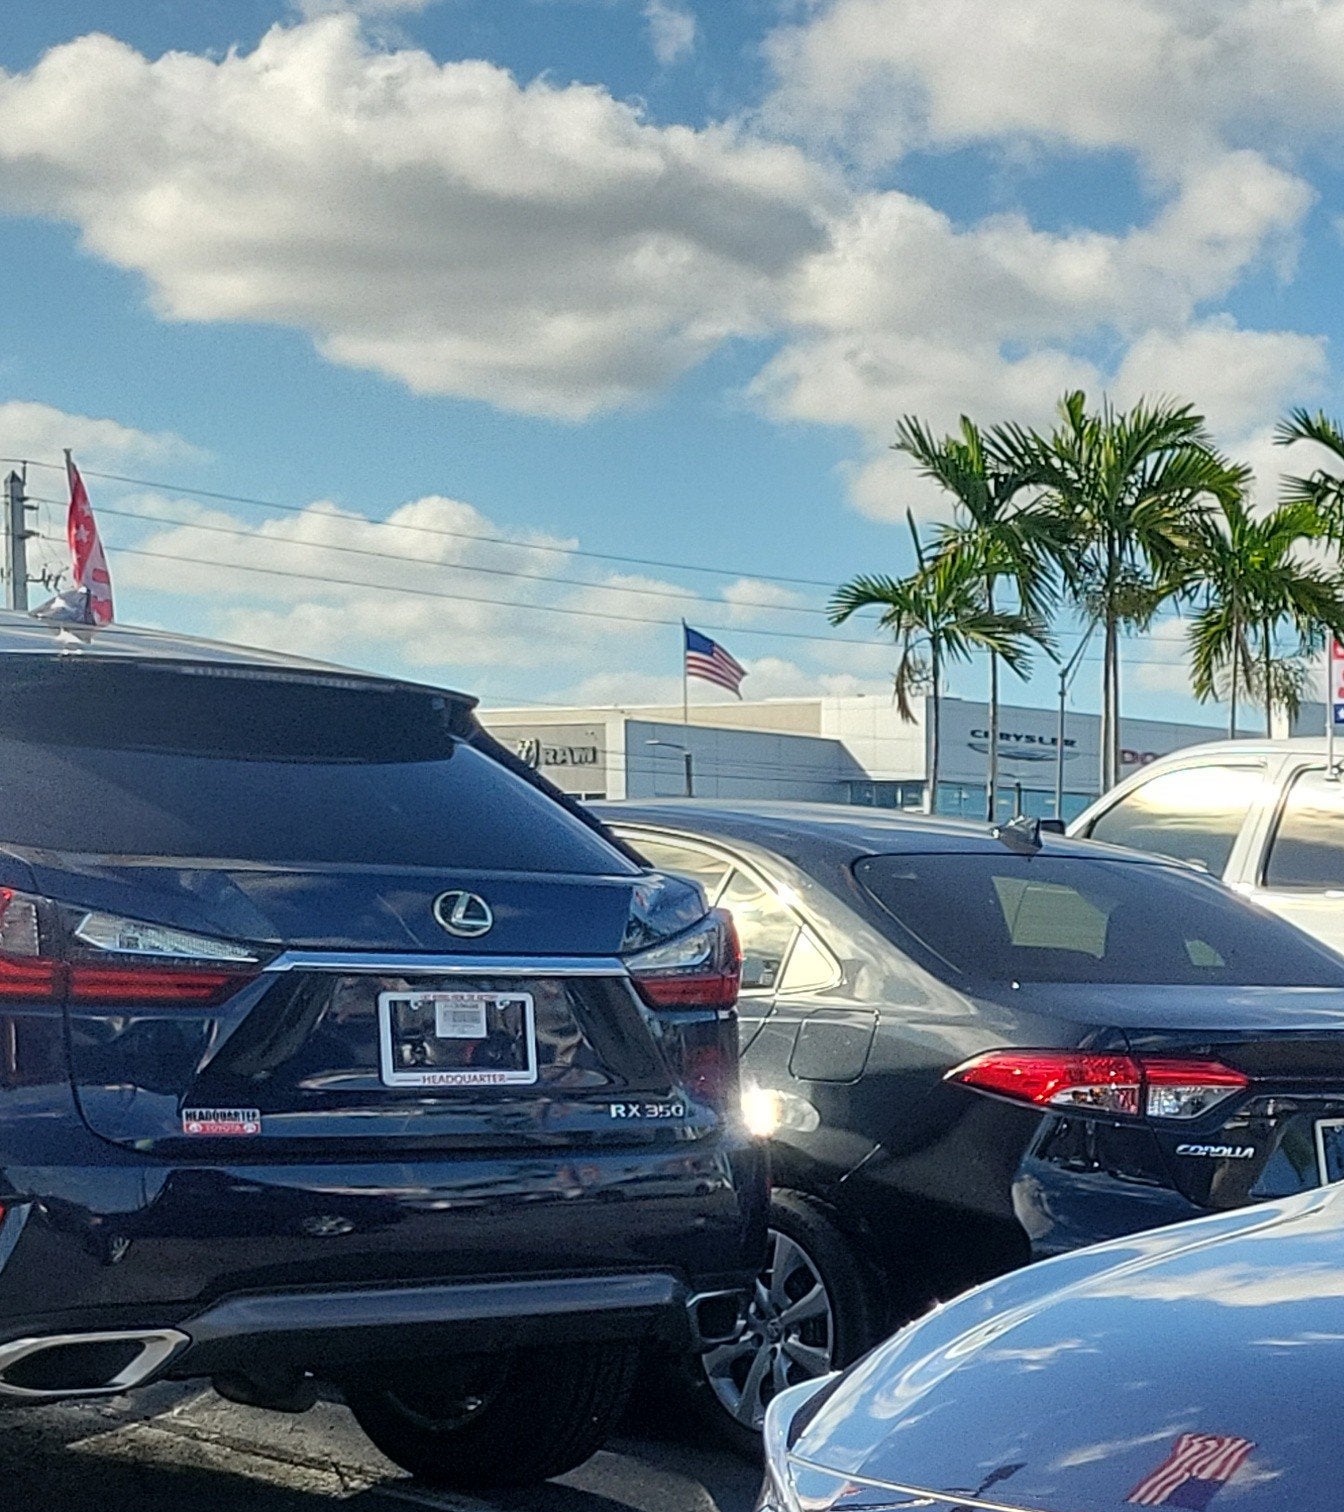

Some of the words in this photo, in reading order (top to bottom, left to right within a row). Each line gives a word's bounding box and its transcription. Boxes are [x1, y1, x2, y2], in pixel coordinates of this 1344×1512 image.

[544, 747, 597, 766] RAM
[421, 1073, 506, 1085] HEADQUARTER
[184, 1109, 259, 1122] HEADQUARTER
[610, 1103, 641, 1118] RX
[645, 1102, 684, 1118] 350
